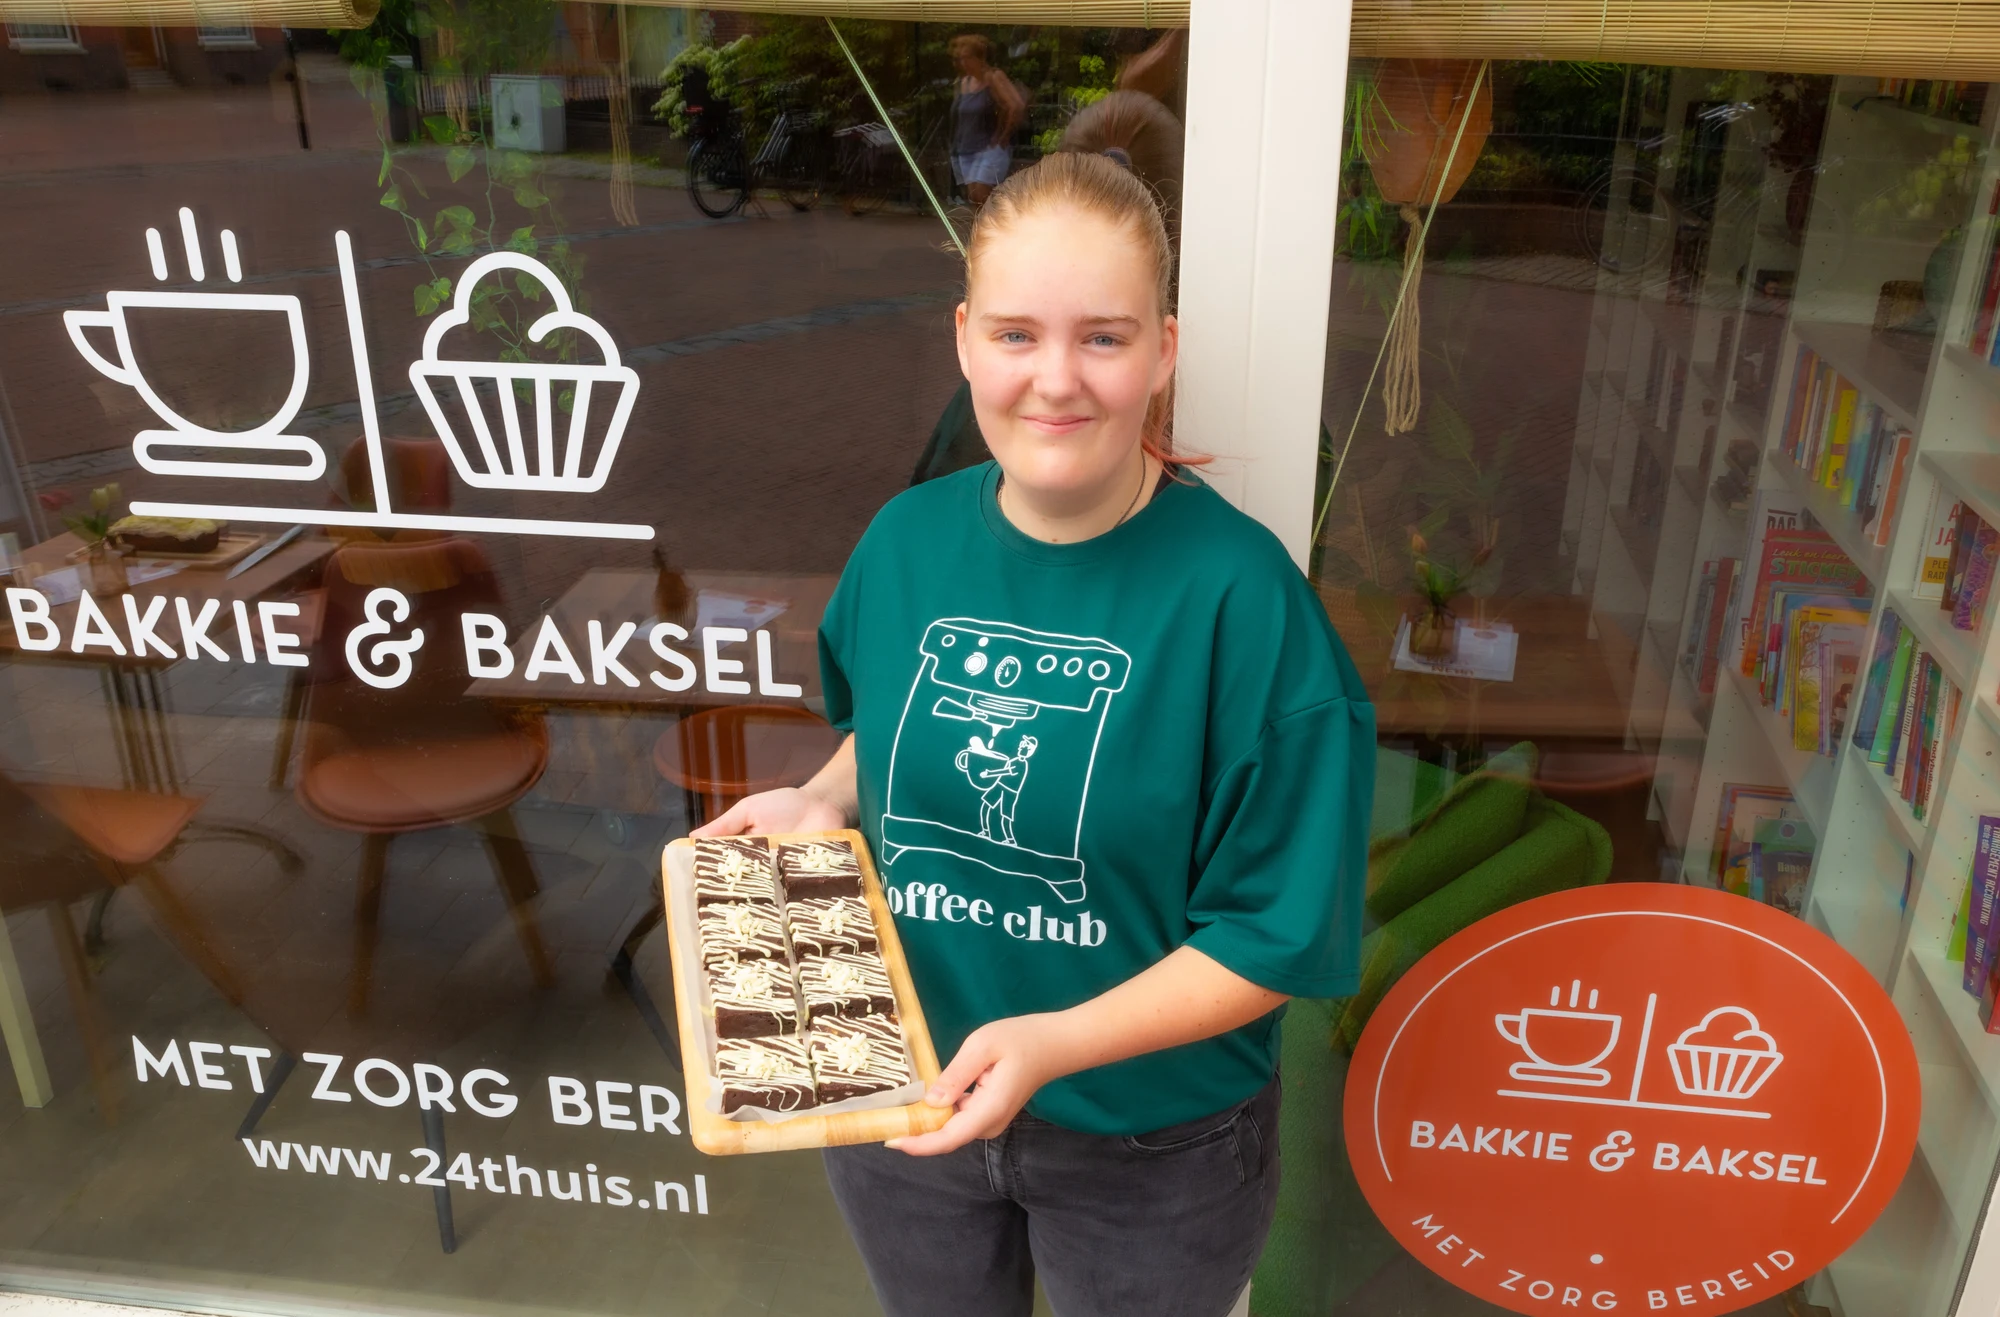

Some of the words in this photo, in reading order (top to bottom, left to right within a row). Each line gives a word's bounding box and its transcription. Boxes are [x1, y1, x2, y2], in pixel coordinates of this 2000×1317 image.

[1769, 557, 1862, 580] STICKER
[1772, 548, 1802, 558] Leuk
[6, 588, 309, 667] BAKKIE
[345, 588, 424, 689] &
[461, 613, 802, 698] BAKSEL
[1902, 701, 1916, 737] Animal
[1924, 739, 1939, 802] bodybuilding
[1986, 826, 2000, 879] MANAGEMENT
[881, 872, 994, 926] offee
[1004, 906, 1107, 947] club
[1979, 879, 1996, 926] ACCOUNTING
[132, 1036, 271, 1094] MET
[303, 1053, 518, 1118] ZORG
[548, 1076, 691, 1136] BER
[242, 1138, 709, 1215] www.24thuis.nl
[1410, 1120, 1573, 1161] BAKKIE
[1589, 1130, 1636, 1172] &
[1652, 1142, 1827, 1186] BAKSEL
[1412, 1214, 1485, 1267] MET
[1499, 1269, 1617, 1310] ZORG
[1648, 1249, 1796, 1310] BEREID
